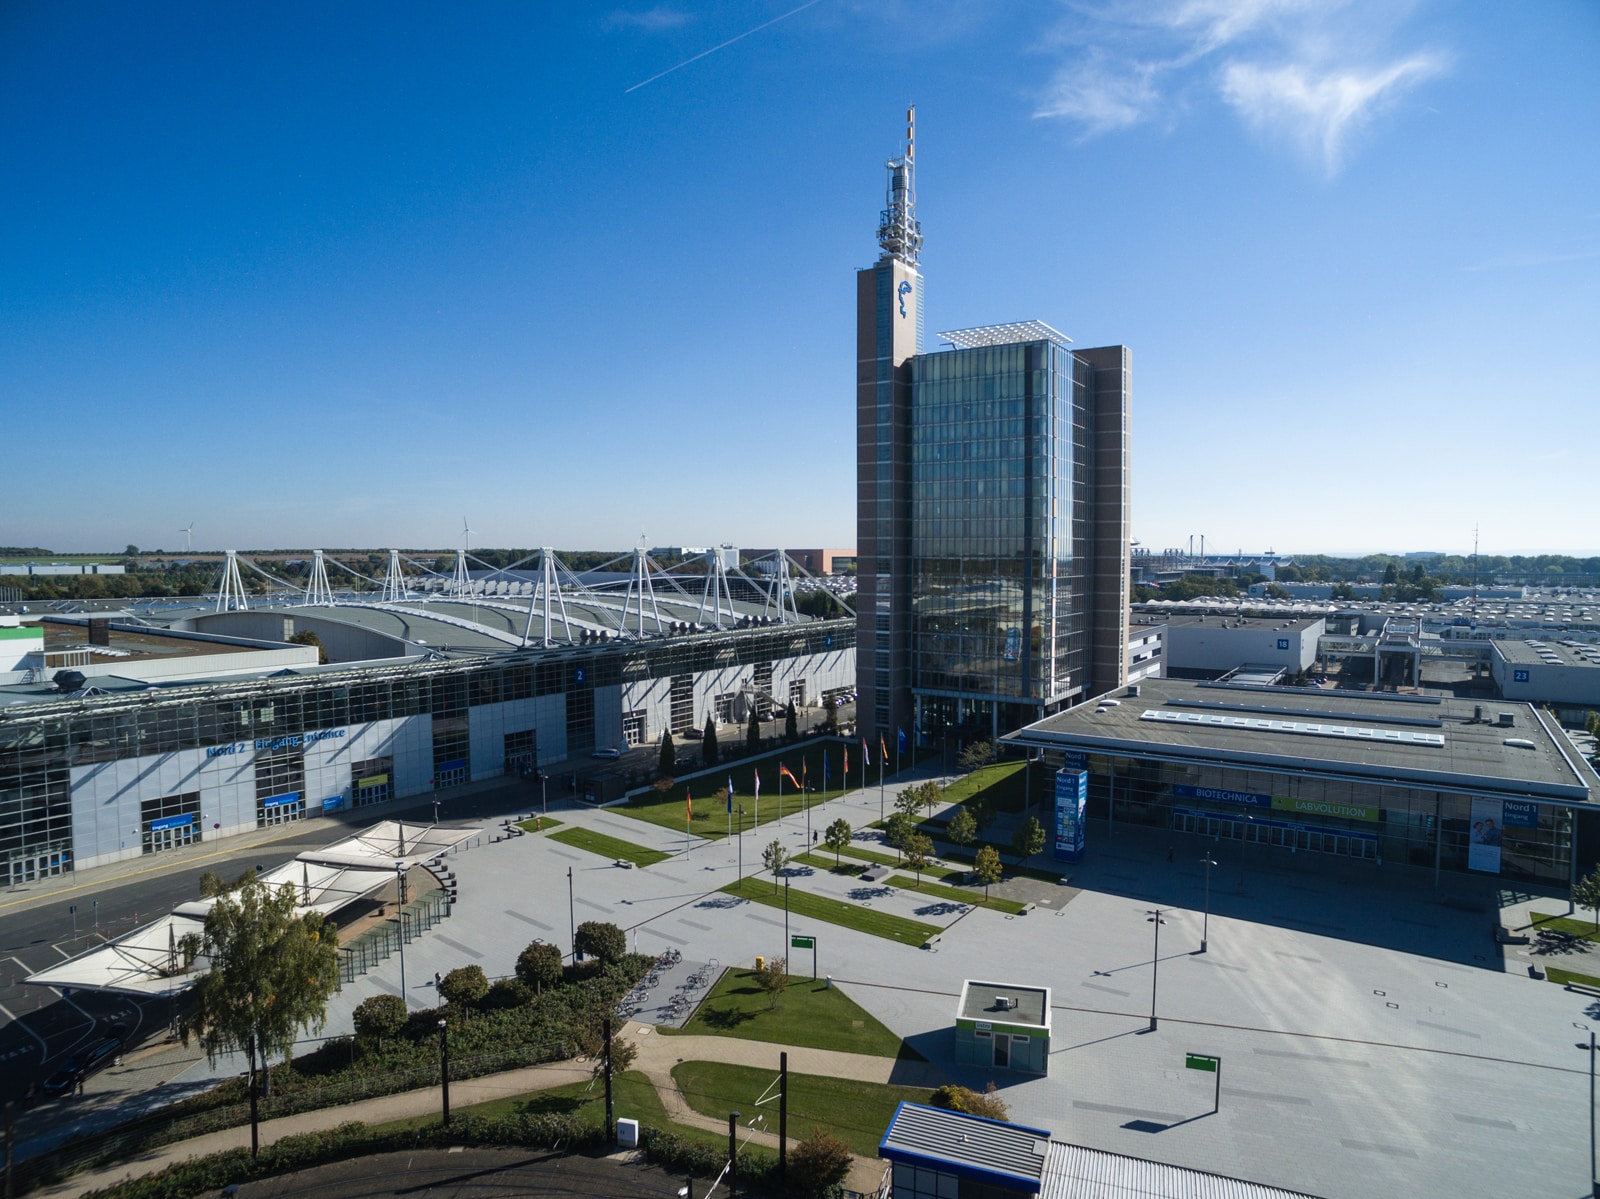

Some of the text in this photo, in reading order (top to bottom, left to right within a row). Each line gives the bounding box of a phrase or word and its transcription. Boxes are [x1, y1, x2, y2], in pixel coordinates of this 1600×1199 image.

[577, 670, 583, 680] 2
[1515, 672, 1527, 680] 23
[255, 728, 345, 751] Eingang Entrance
[207, 743, 246, 757] Nord 2
[1065, 752, 1082, 760] Nord
[1057, 776, 1072, 784] Nord
[1196, 788, 1258, 804] BIOTECHNICA
[1295, 801, 1366, 817] LABVOLUTION
[1504, 802, 1537, 813] Nord 1
[1504, 812, 1529, 821] Eingang
